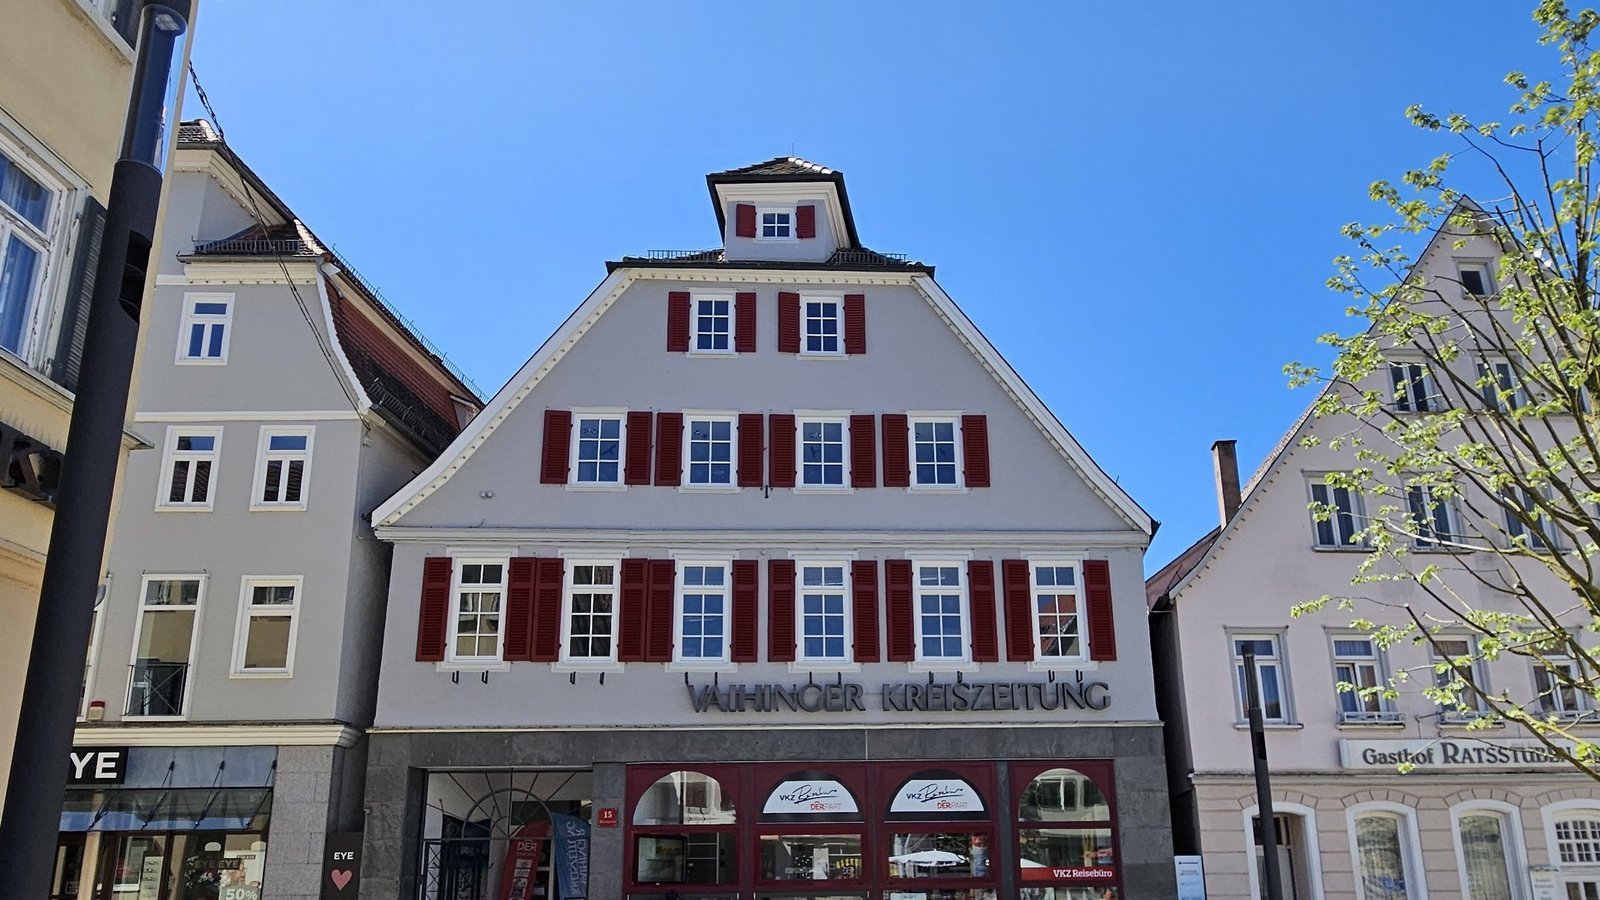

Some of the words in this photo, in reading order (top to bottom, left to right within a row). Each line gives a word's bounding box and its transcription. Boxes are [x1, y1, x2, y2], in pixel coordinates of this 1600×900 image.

[687, 682, 866, 713] VAIHINGER
[882, 681, 1111, 712] KREISZEITUNG
[1362, 747, 1435, 766] Gasthof
[69, 752, 120, 779] YE
[604, 810, 613, 819] 15
[517, 840, 537, 852] DER
[333, 851, 354, 861] EYE
[1053, 869, 1072, 878] VKZ
[1072, 868, 1113, 878] Reisebüro
[225, 888, 258, 900] 50%
